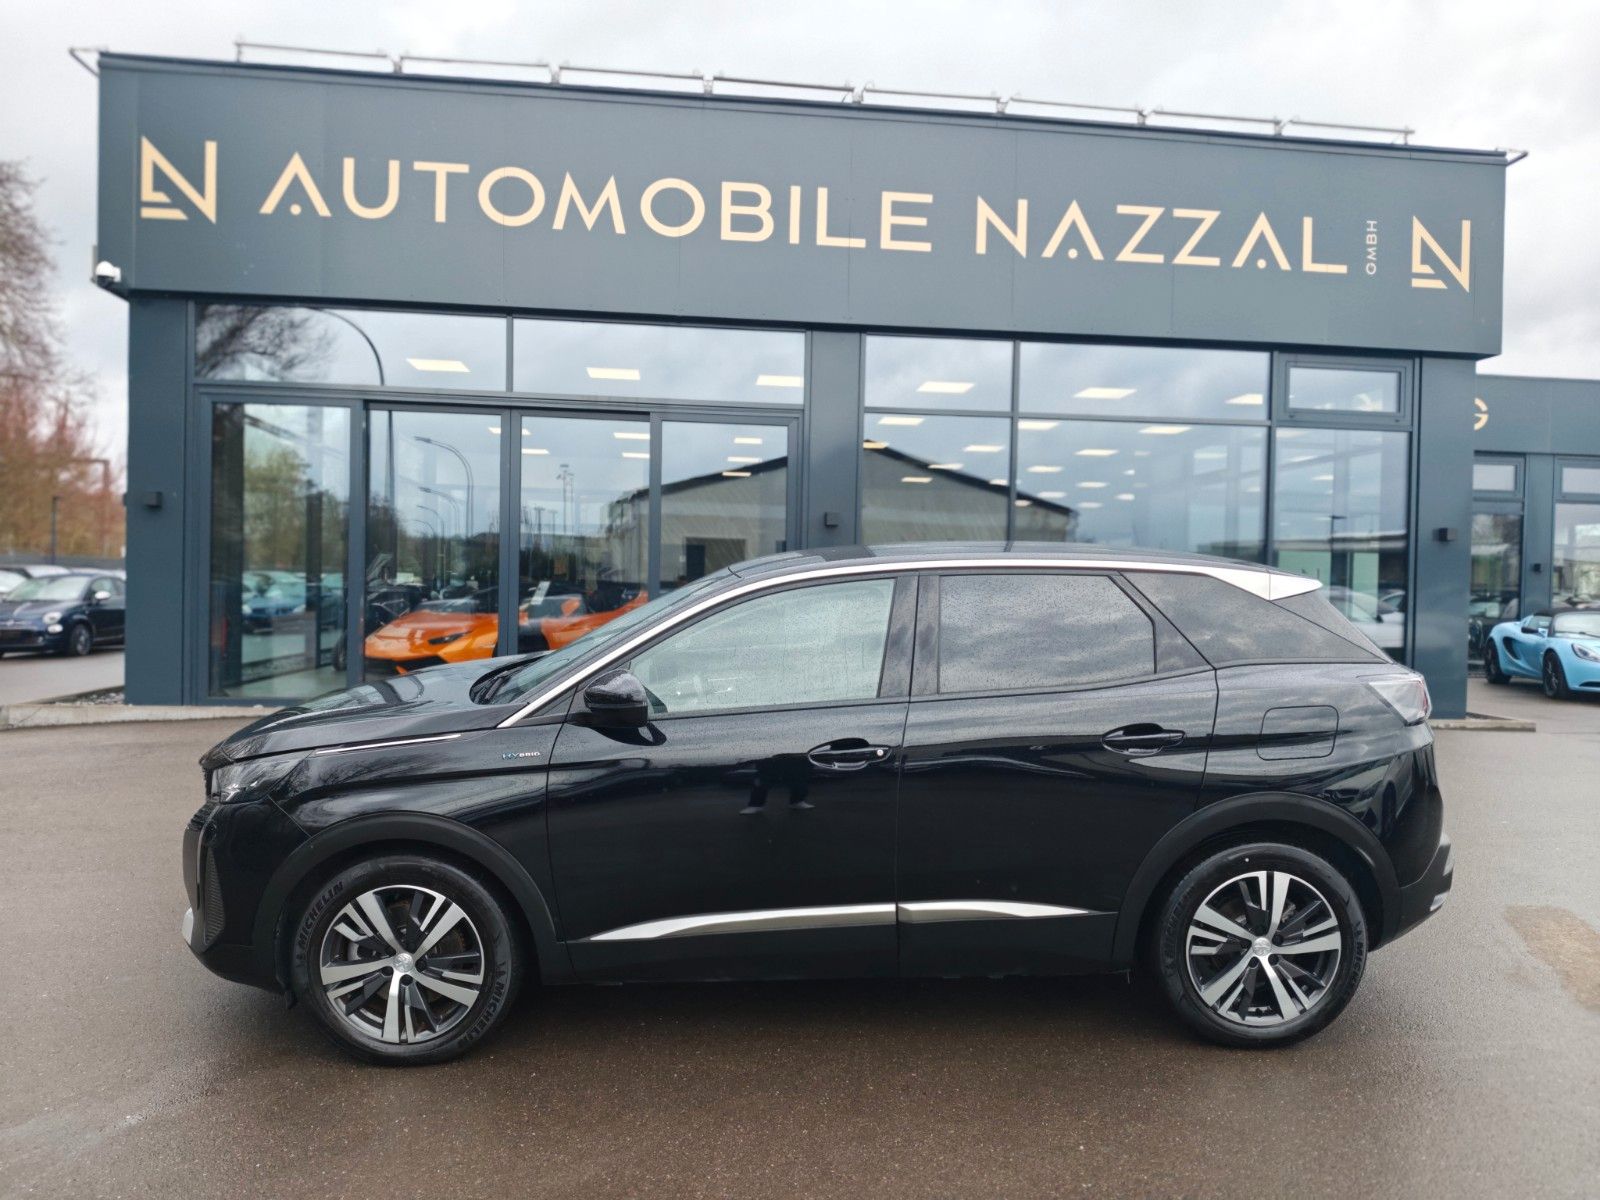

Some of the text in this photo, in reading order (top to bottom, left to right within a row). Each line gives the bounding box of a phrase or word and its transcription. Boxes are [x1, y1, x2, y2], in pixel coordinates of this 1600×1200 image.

[260, 153, 1348, 274] AUTOMOBILE NAZZAL
[1365, 220, 1378, 276] GMBH
[297, 881, 344, 950] MICHELIN
